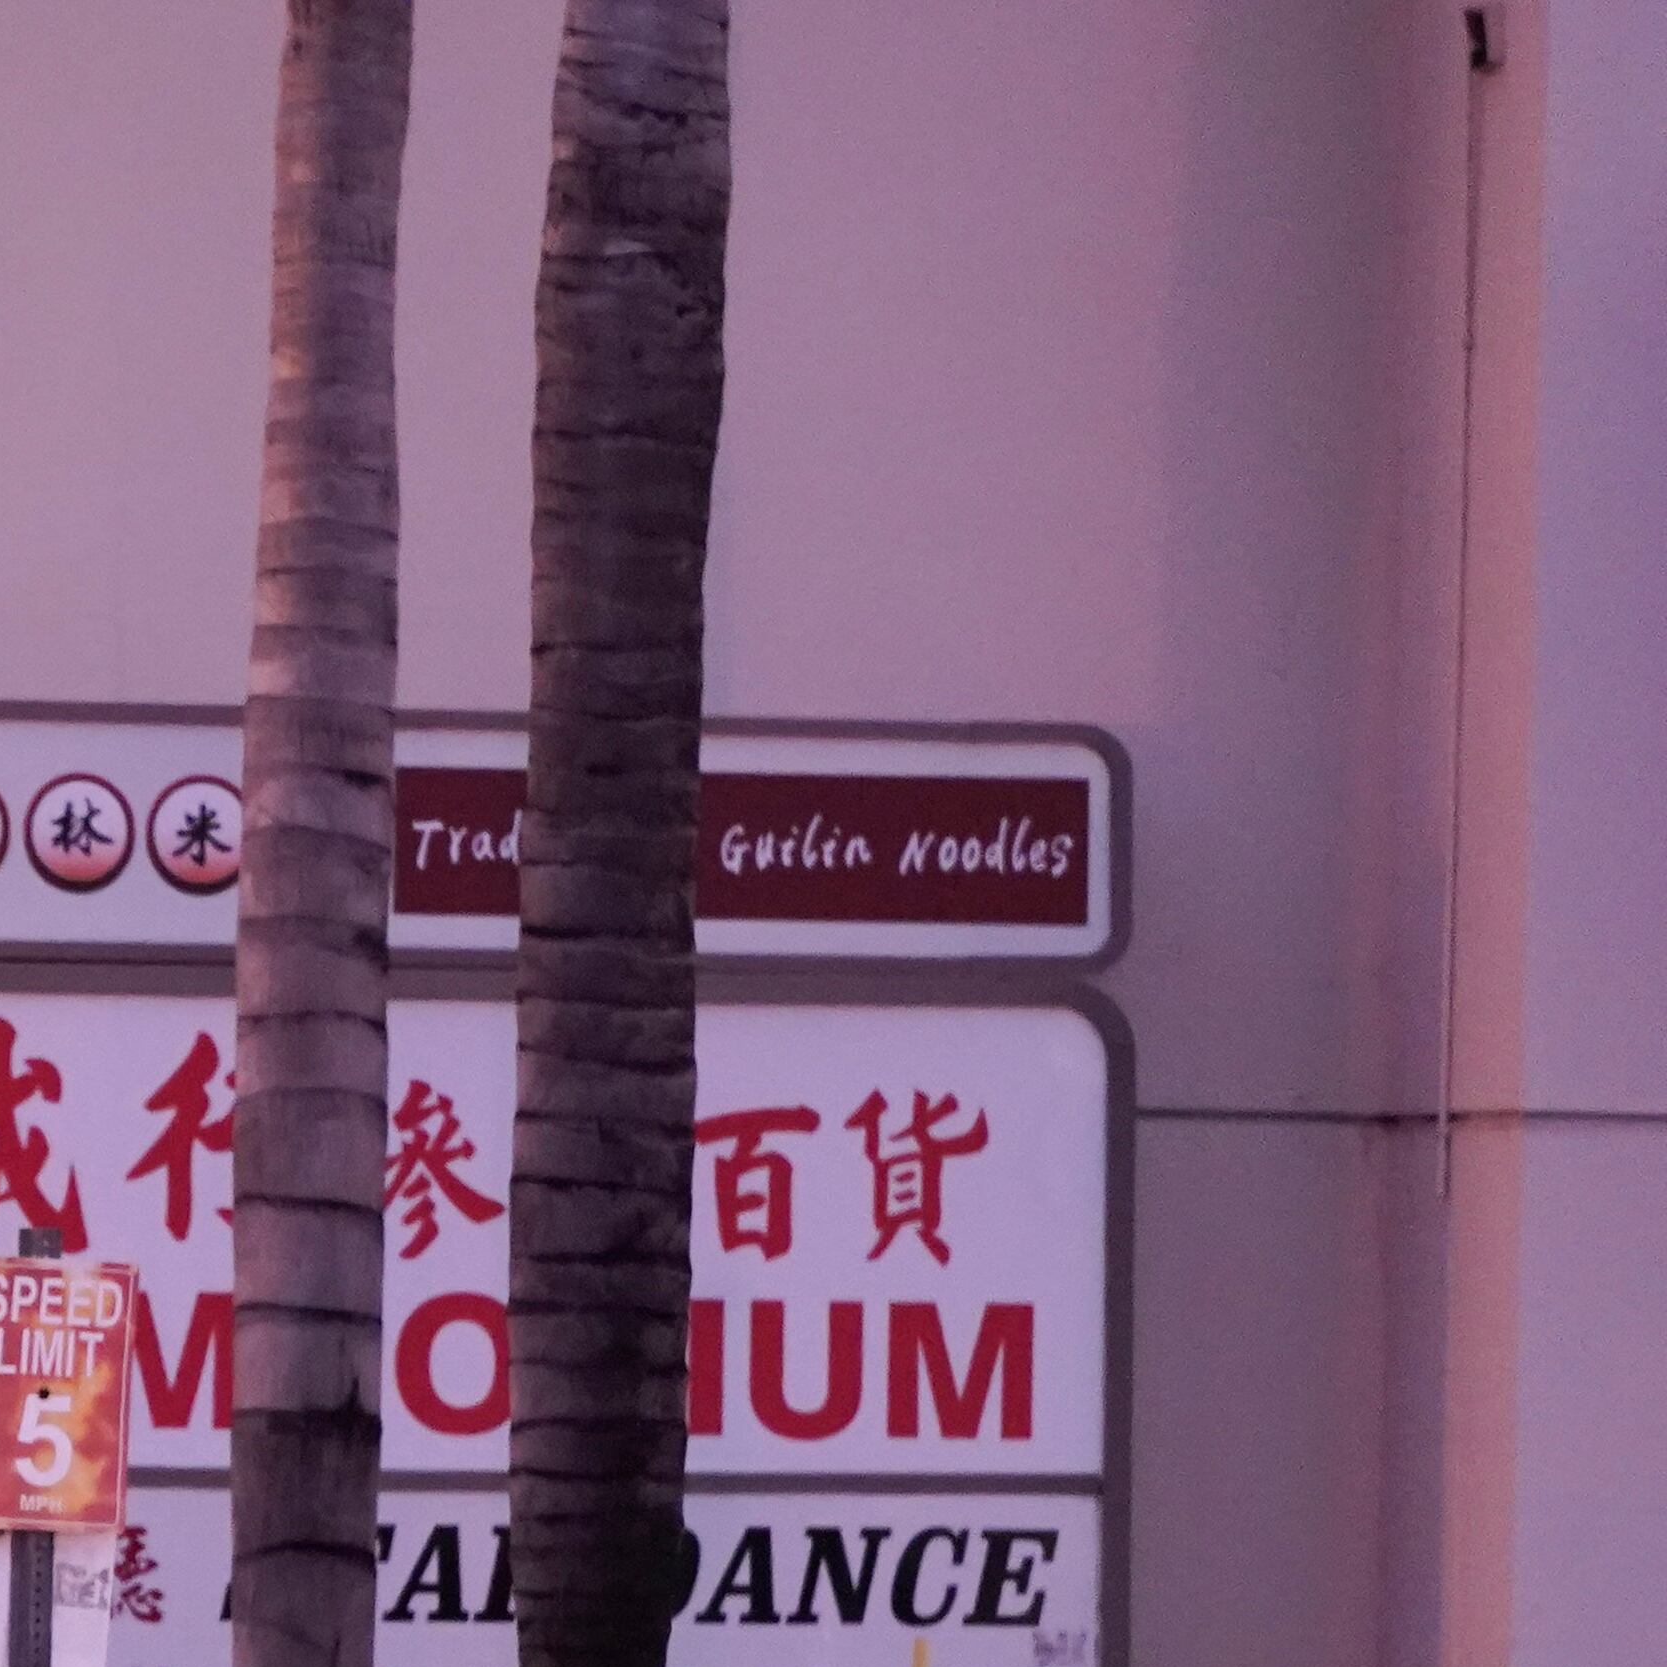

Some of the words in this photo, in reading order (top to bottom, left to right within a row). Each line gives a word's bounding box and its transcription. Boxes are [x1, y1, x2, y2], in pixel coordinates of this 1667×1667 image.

[719, 812, 873, 875] Guilin
[898, 816, 1075, 880] Noodles
[15, 1392, 72, 1488] 5
